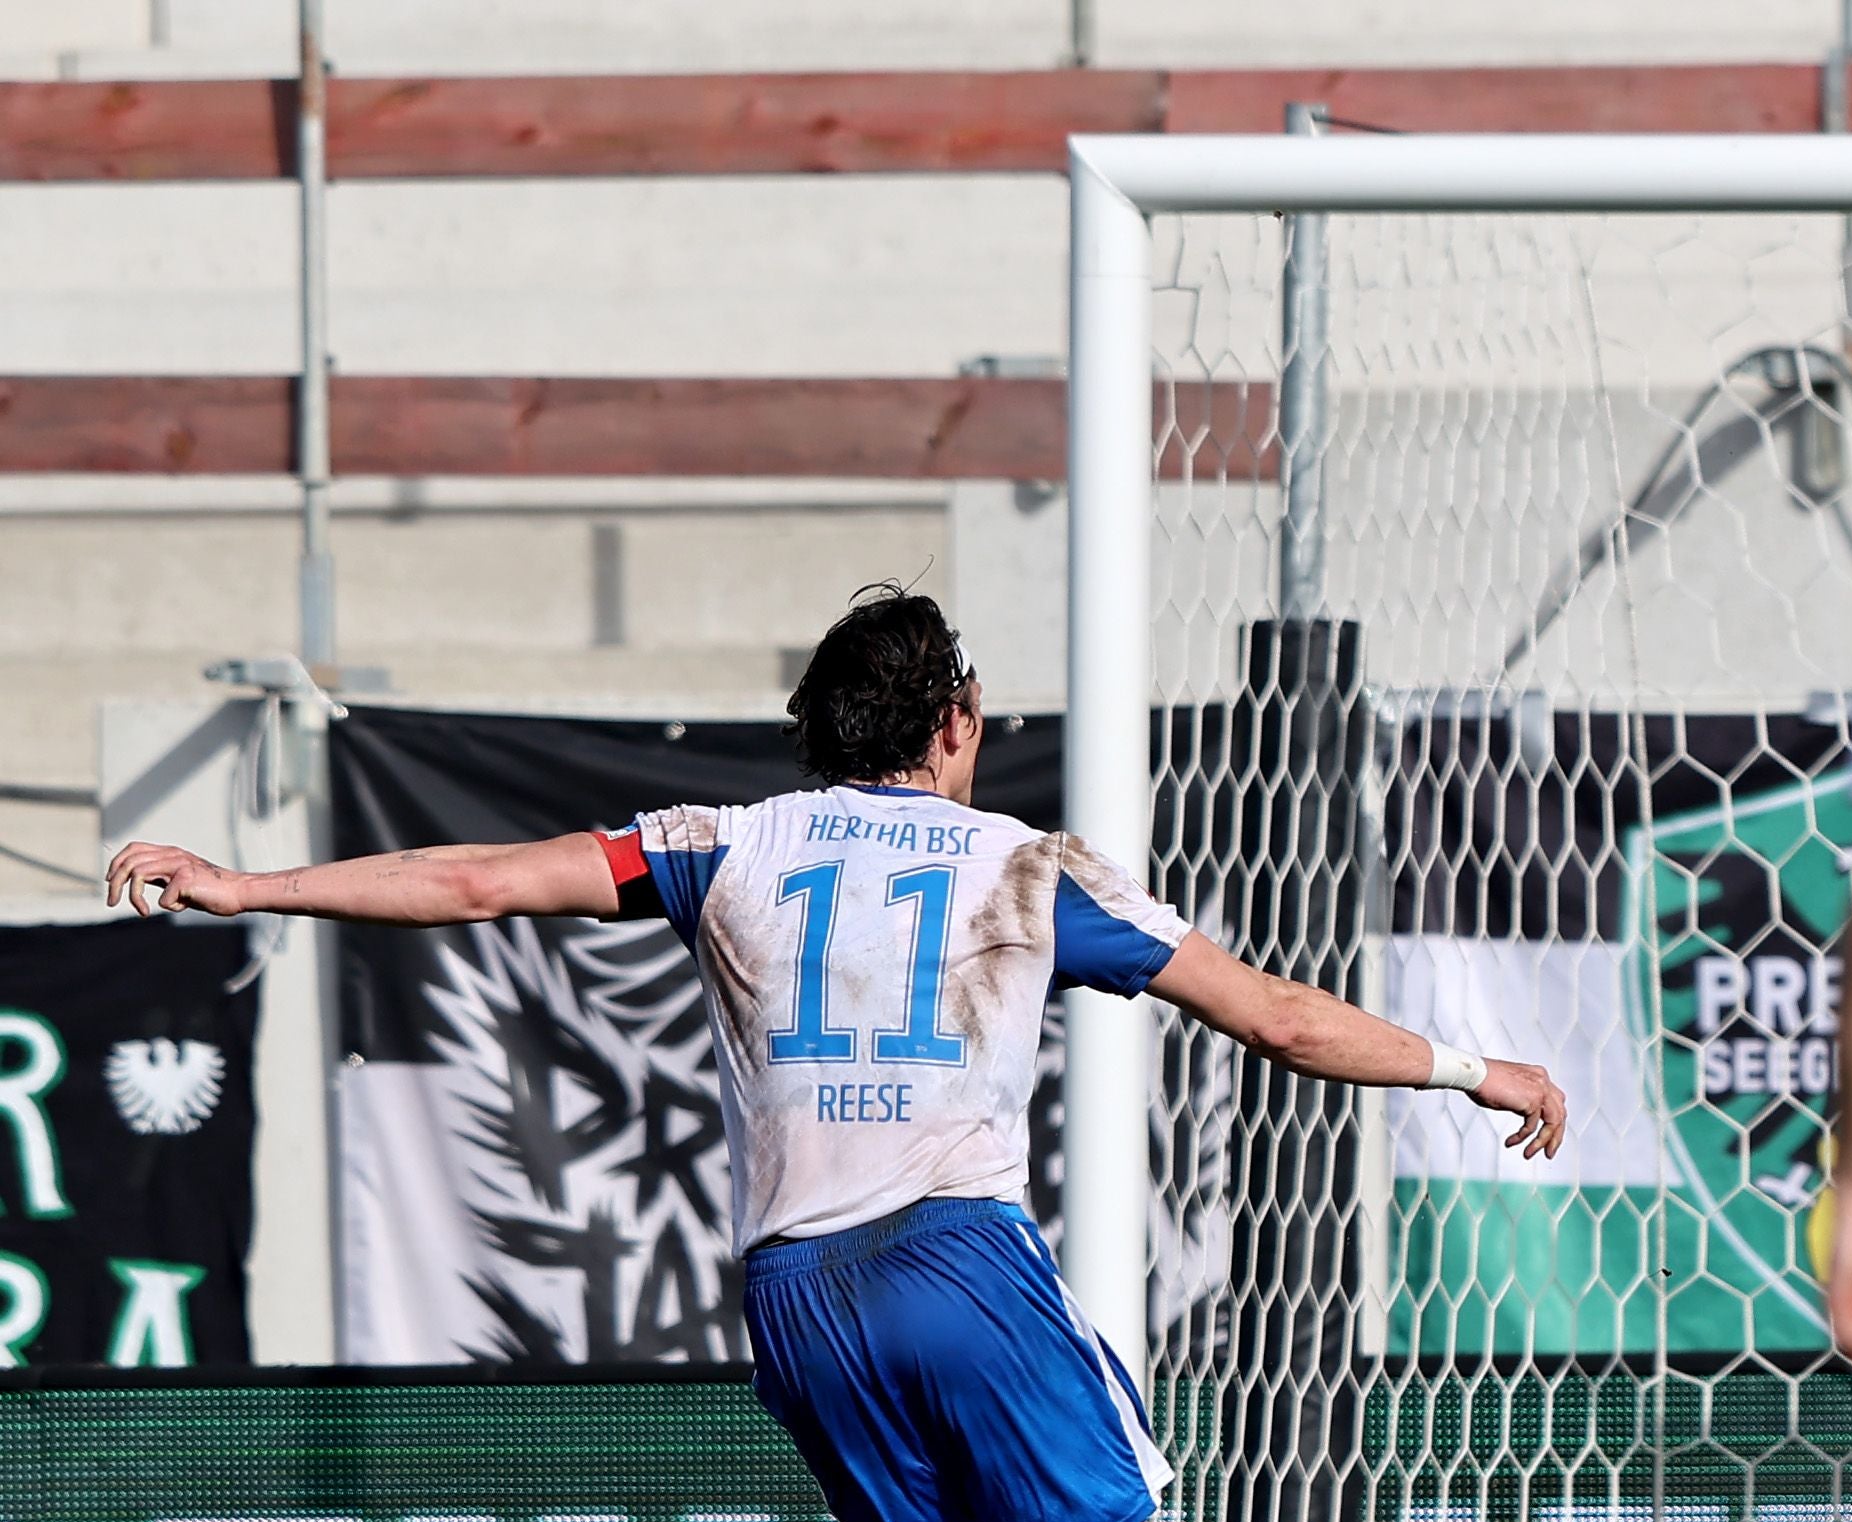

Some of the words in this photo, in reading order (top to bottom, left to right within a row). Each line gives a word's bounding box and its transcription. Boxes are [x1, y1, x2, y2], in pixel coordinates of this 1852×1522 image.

[806, 813, 917, 852] HERTHA
[926, 826, 982, 856] BSC
[767, 859, 967, 1067] 11
[817, 1083, 912, 1124] REESE
